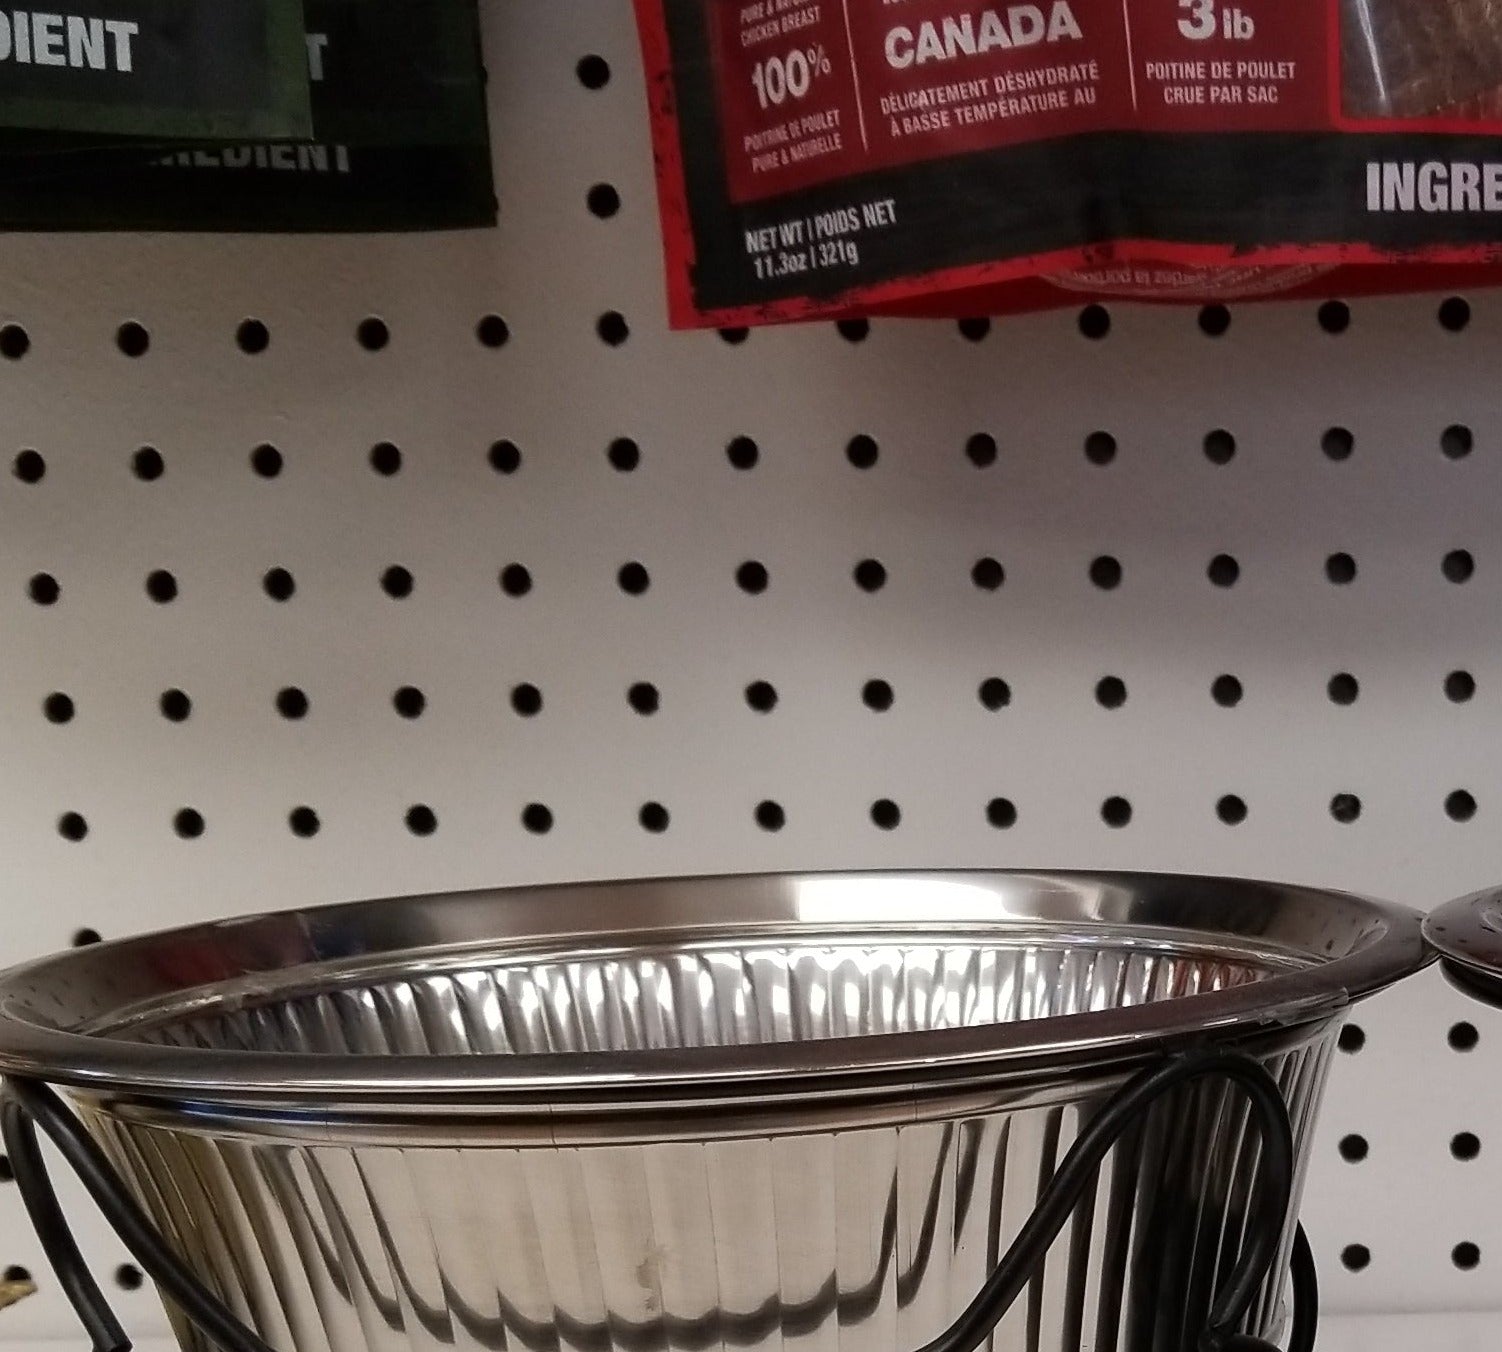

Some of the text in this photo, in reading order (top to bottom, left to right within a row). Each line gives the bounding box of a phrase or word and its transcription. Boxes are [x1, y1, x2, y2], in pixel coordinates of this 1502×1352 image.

[781, 5, 820, 33] BREAST
[884, 0, 1084, 69] CANADA
[752, 43, 832, 110] 100%
[880, 59, 1100, 115] DÉLICATEMENT DÉSHYDRATÉ
[1164, 85, 1279, 104] CRUE PAR SAC
[1211, 61, 1233, 80] DE
[1237, 61, 1297, 80] POULET
[903, 112, 951, 135] BASSE
[954, 90, 1070, 126] TEMPÉRATURE
[1074, 87, 1097, 106] AU
[745, 227, 777, 253] NET
[779, 220, 803, 247] WT
[814, 207, 860, 239] POIDS
[862, 199, 897, 228] NET
[818, 239, 860, 265] 321g
